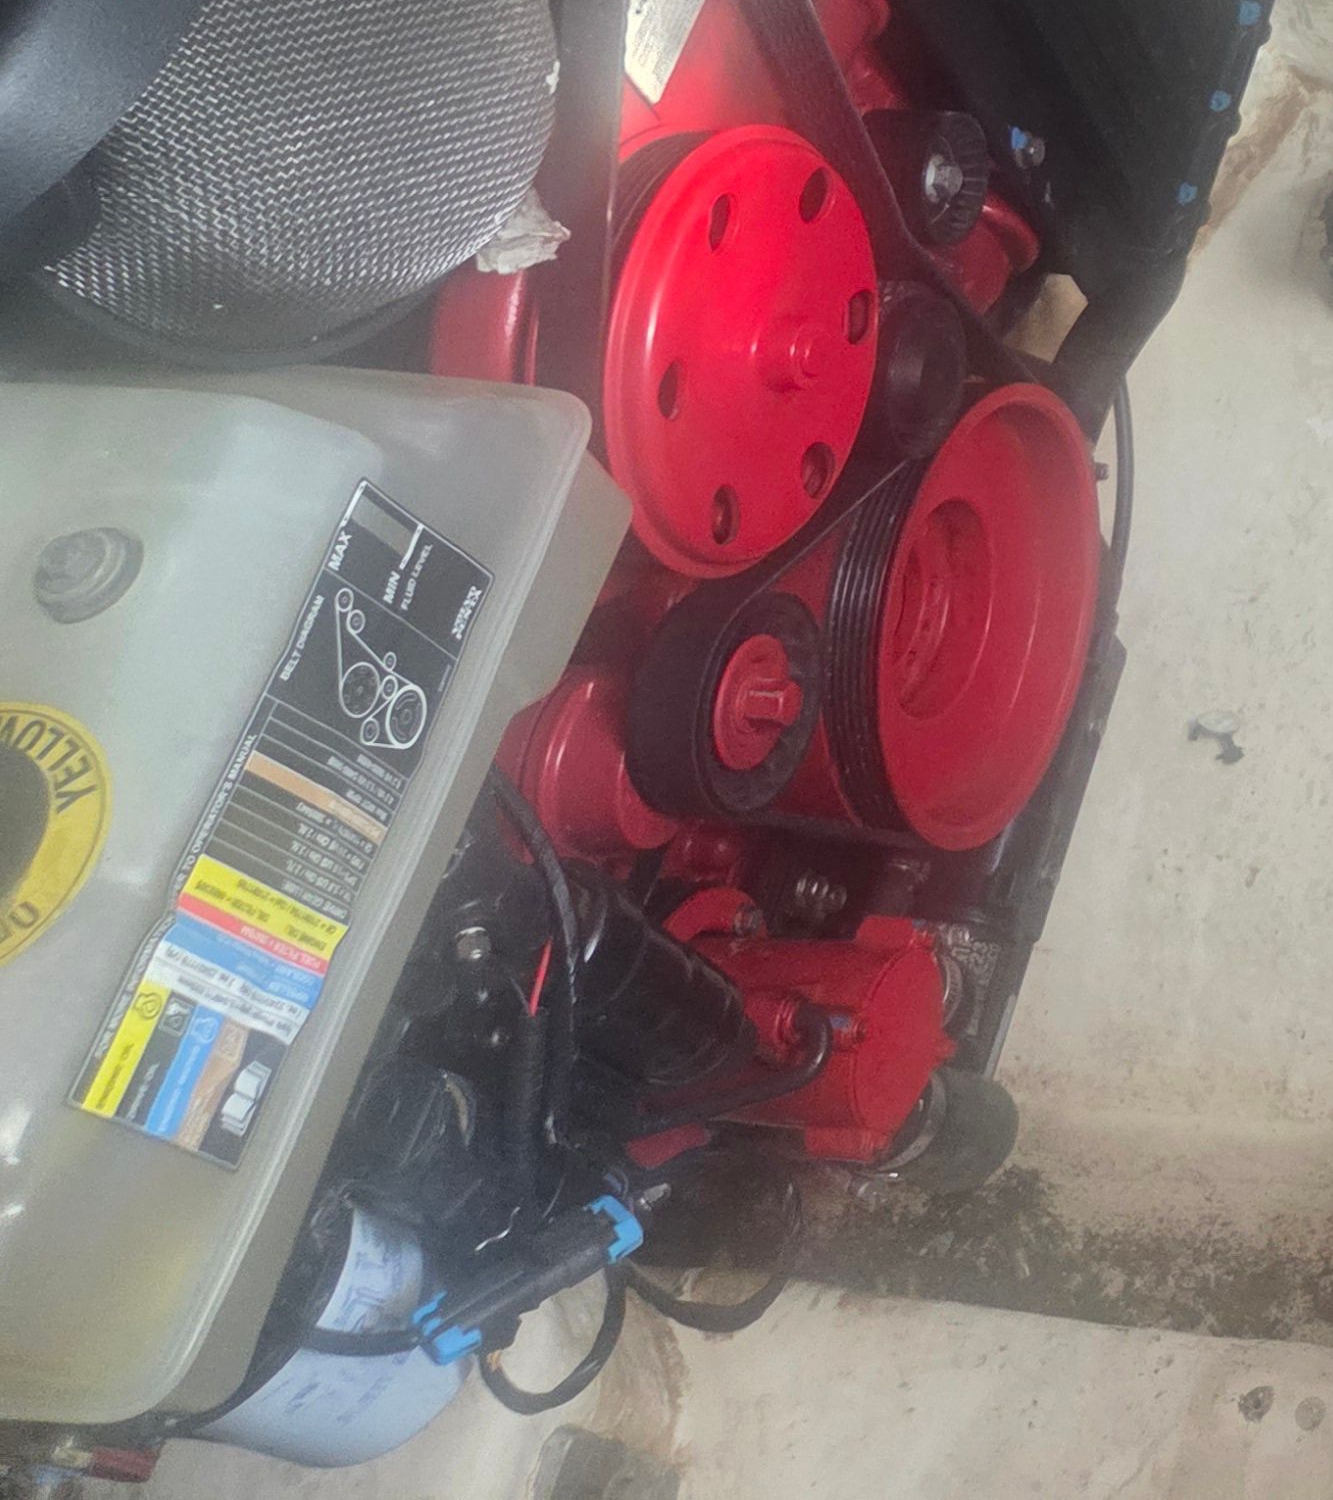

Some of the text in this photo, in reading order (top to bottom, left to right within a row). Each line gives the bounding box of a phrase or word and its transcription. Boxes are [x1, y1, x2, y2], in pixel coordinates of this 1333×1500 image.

[325, 529, 354, 572] MAX
[397, 540, 435, 611] FLUID LEVEL
[379, 569, 404, 604] MIN
[278, 593, 326, 682] BELT DIAGRAM
[181, 853, 197, 873] TO
[189, 779, 234, 855] OPERATOR'S
[227, 730, 259, 781] MANUAL
